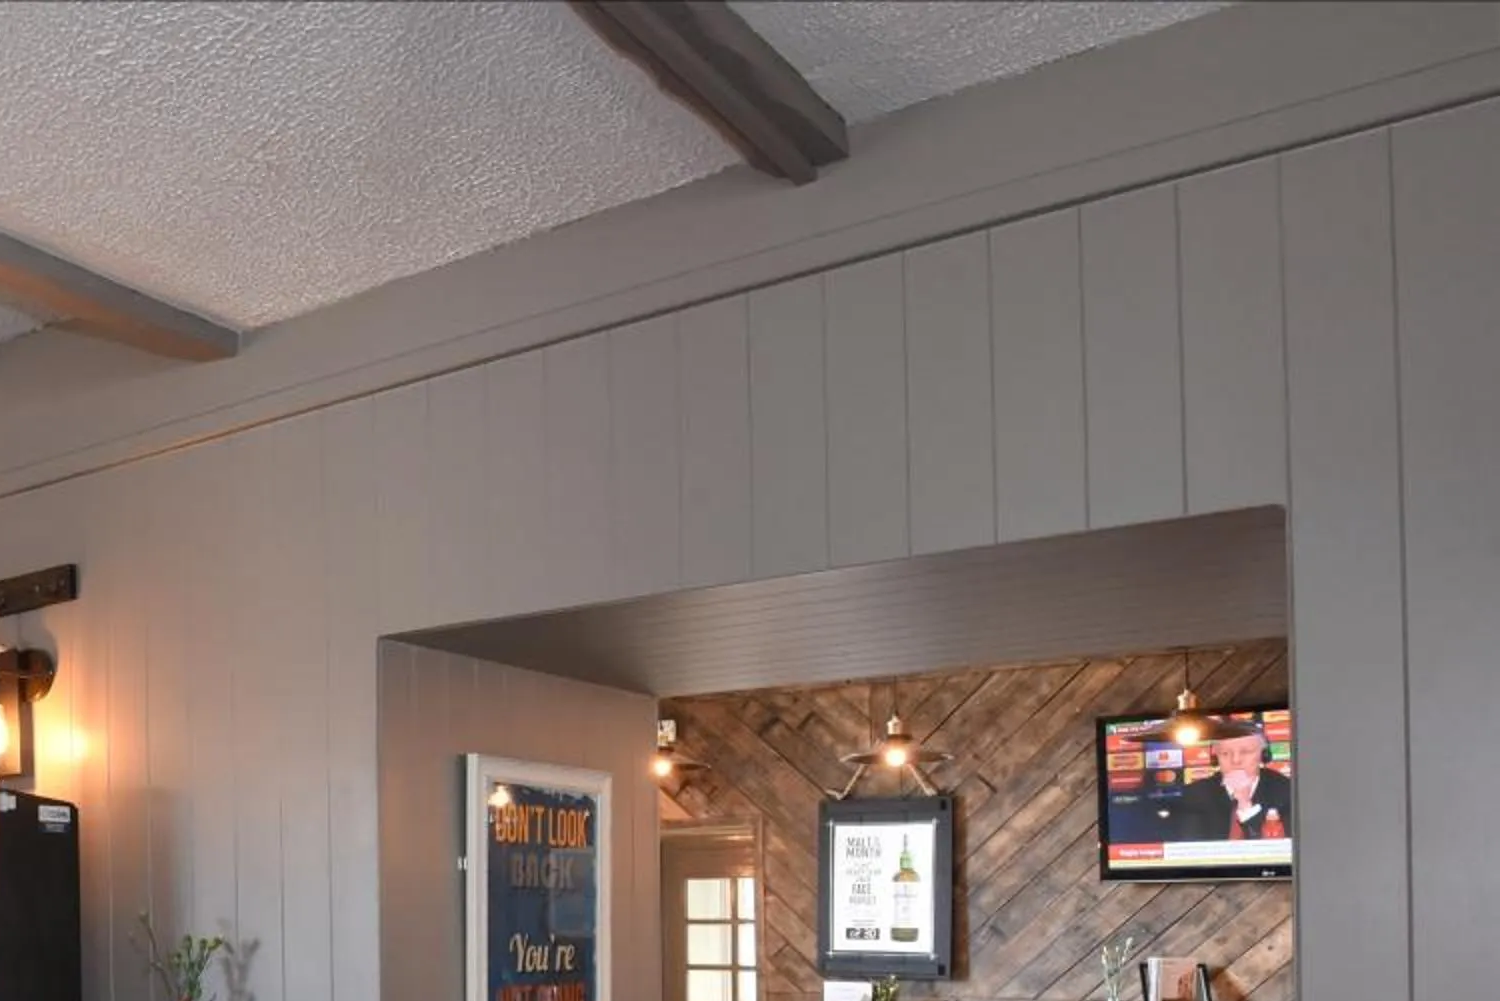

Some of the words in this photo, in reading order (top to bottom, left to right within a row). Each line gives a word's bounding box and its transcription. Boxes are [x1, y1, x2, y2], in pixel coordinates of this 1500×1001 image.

[495, 803, 545, 844] DON'T
[548, 807, 587, 848] LOOK
[509, 931, 576, 972] You're
